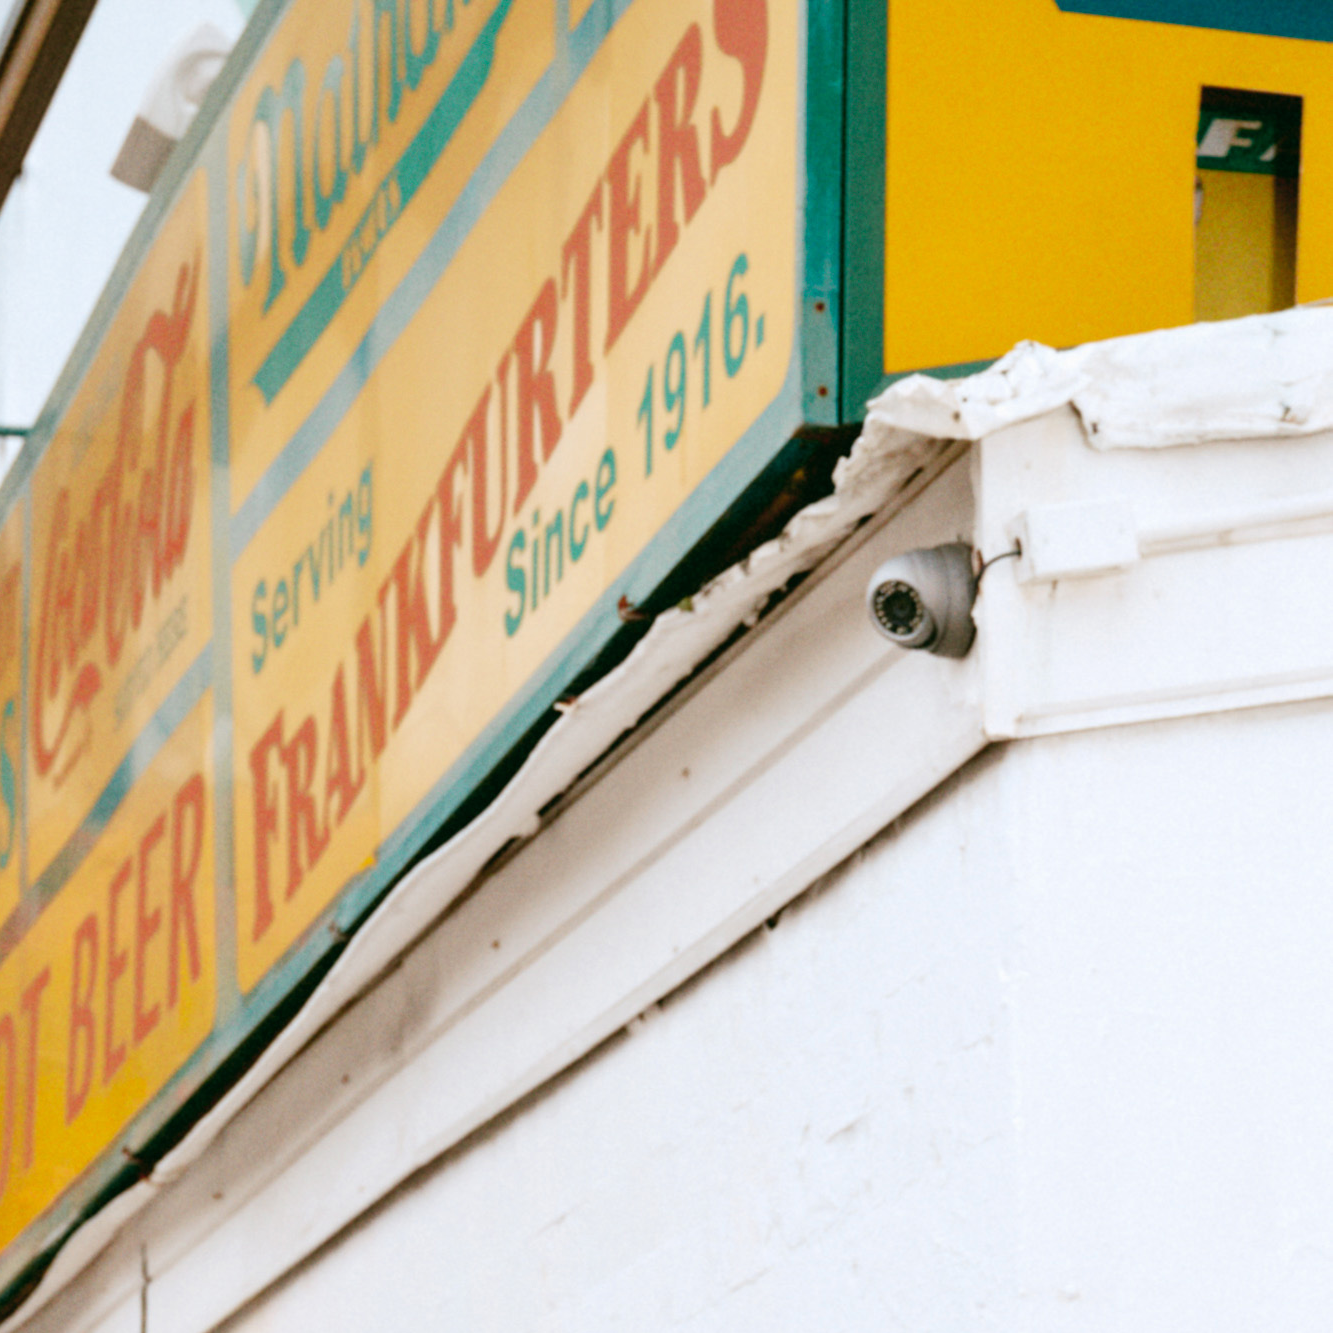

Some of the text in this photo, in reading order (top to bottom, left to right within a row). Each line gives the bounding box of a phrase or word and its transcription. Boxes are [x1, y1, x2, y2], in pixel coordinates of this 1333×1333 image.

[249, 0, 769, 944] FRANKFURTERS
[252, 459, 373, 675] Serving
[503, 252, 766, 638] Since 1916.
[67, 771, 205, 1126] BEER
